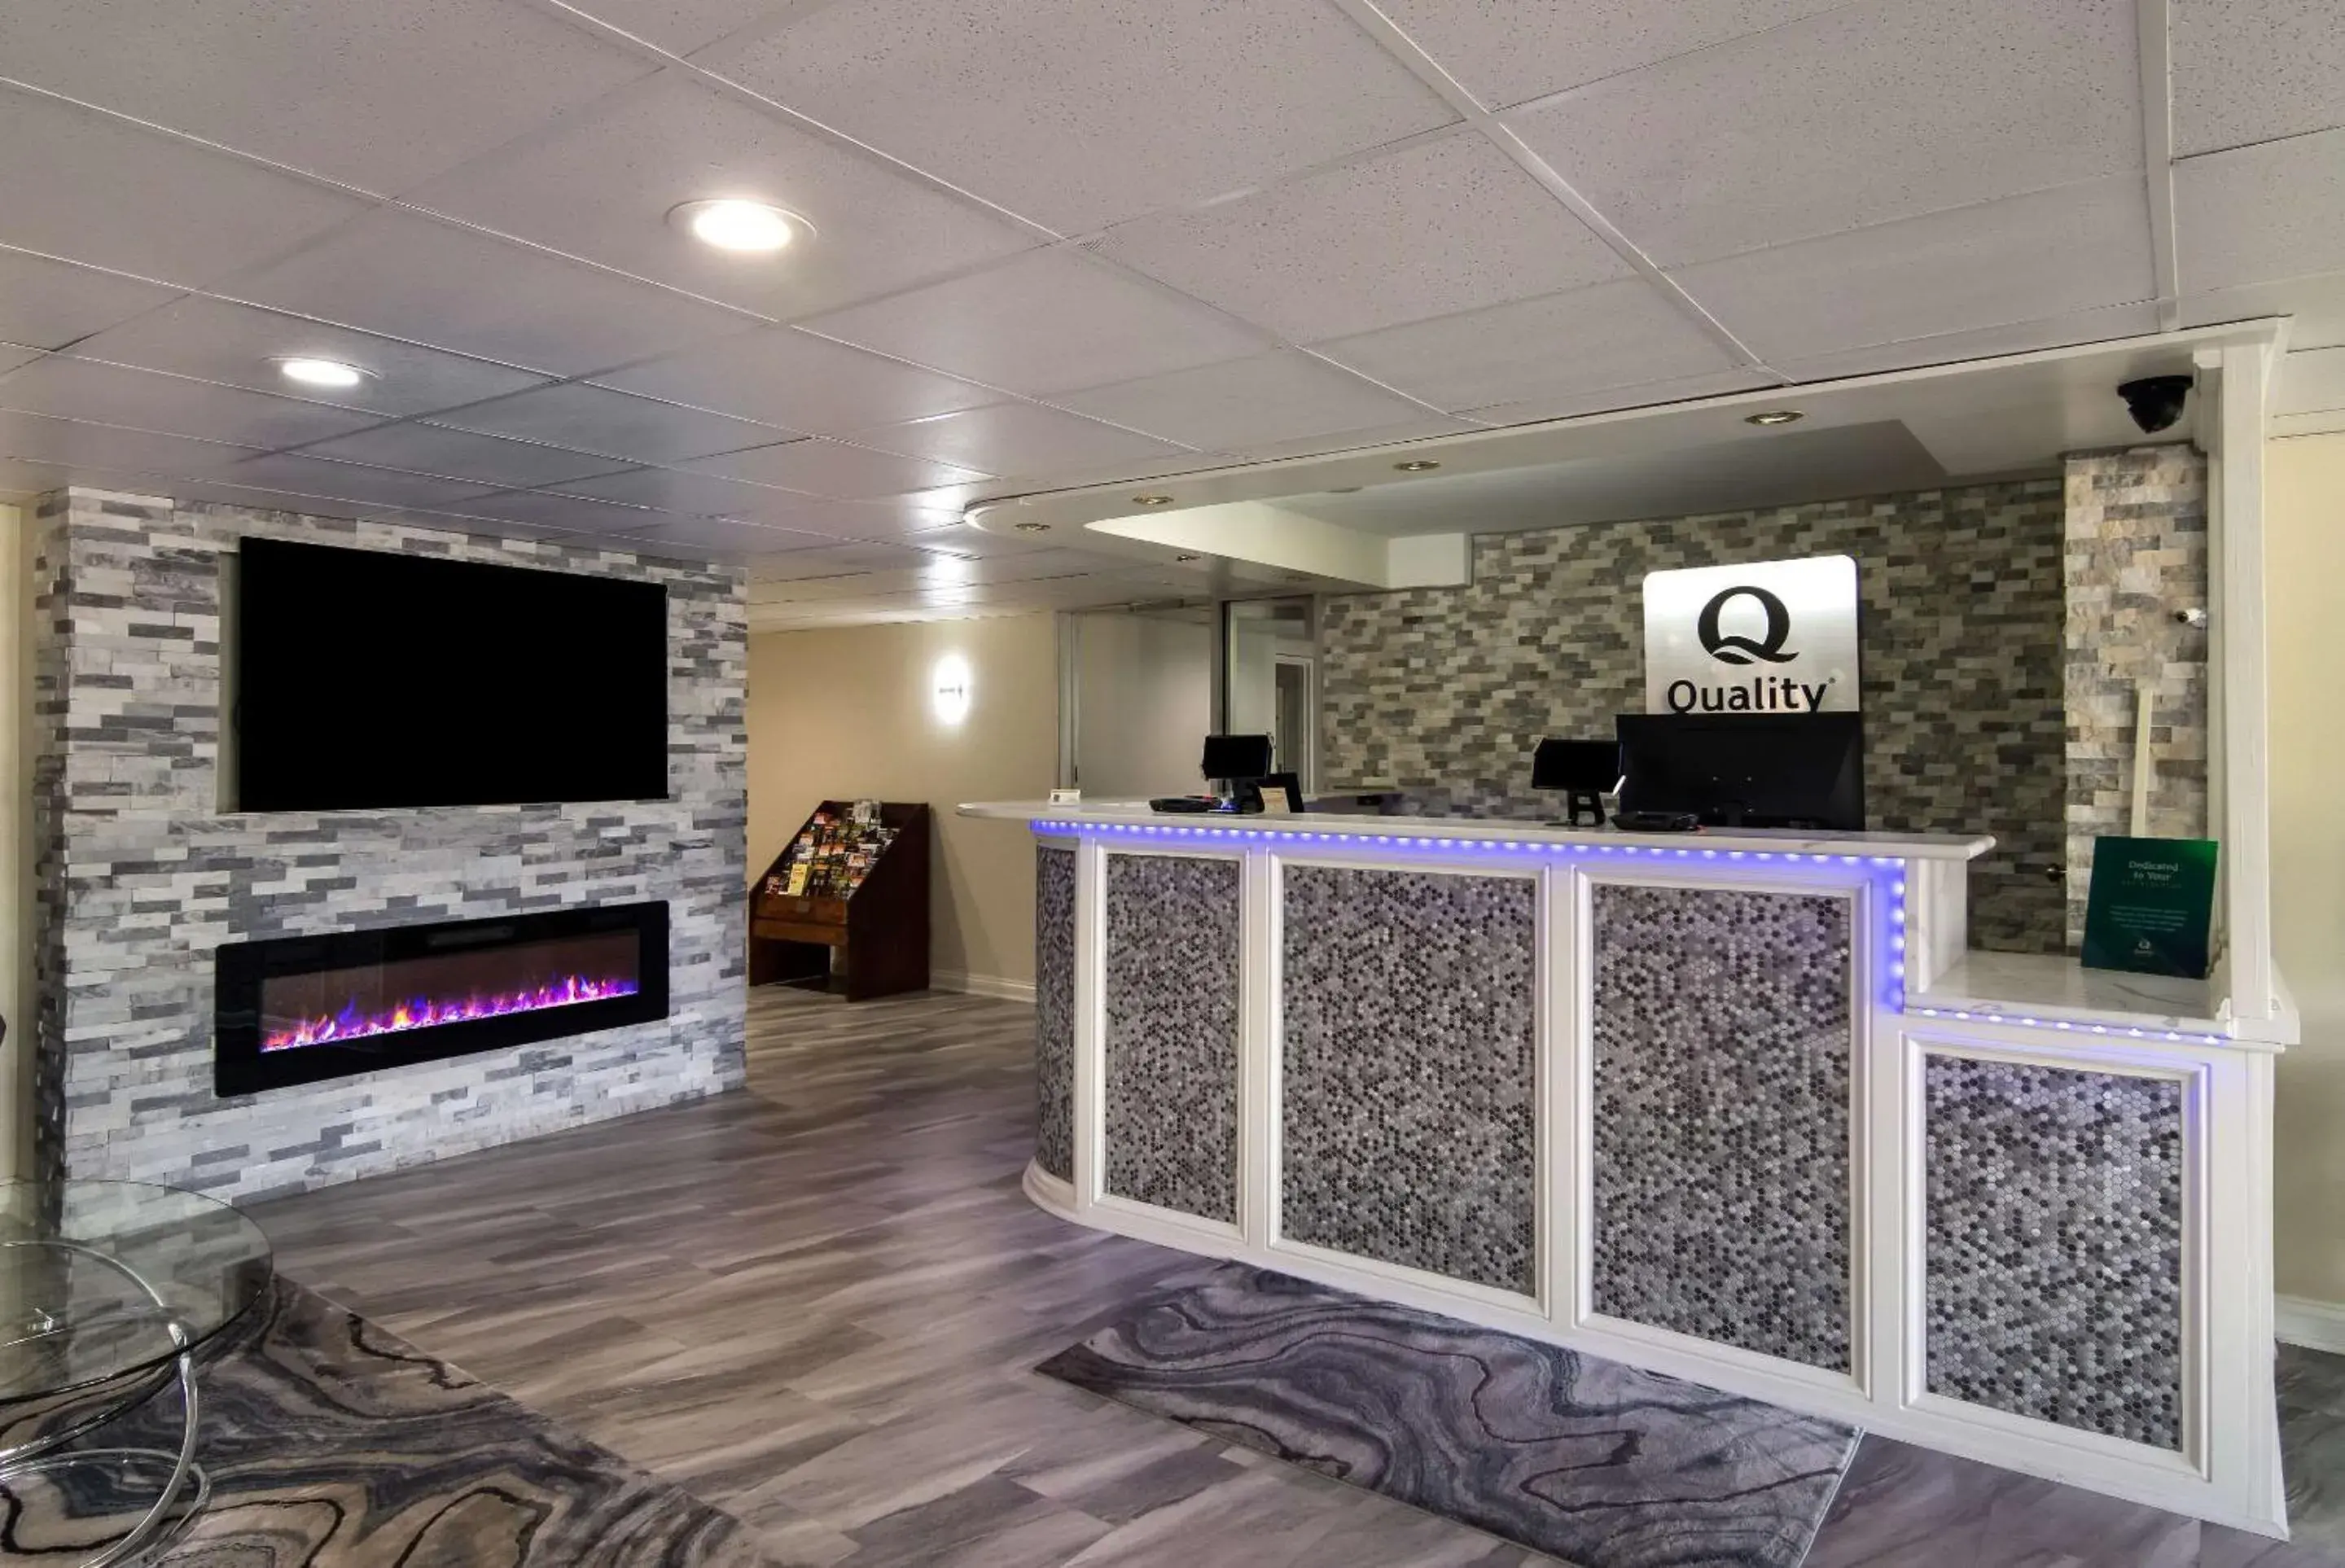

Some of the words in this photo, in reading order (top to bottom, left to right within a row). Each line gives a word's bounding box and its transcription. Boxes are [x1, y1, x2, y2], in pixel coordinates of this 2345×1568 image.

[1698, 585, 1799, 665] Q
[1667, 676, 1827, 713] Quality
[2128, 861, 2179, 872] Dedicated
[2133, 871, 2144, 879] to
[2146, 871, 2172, 881] Your
